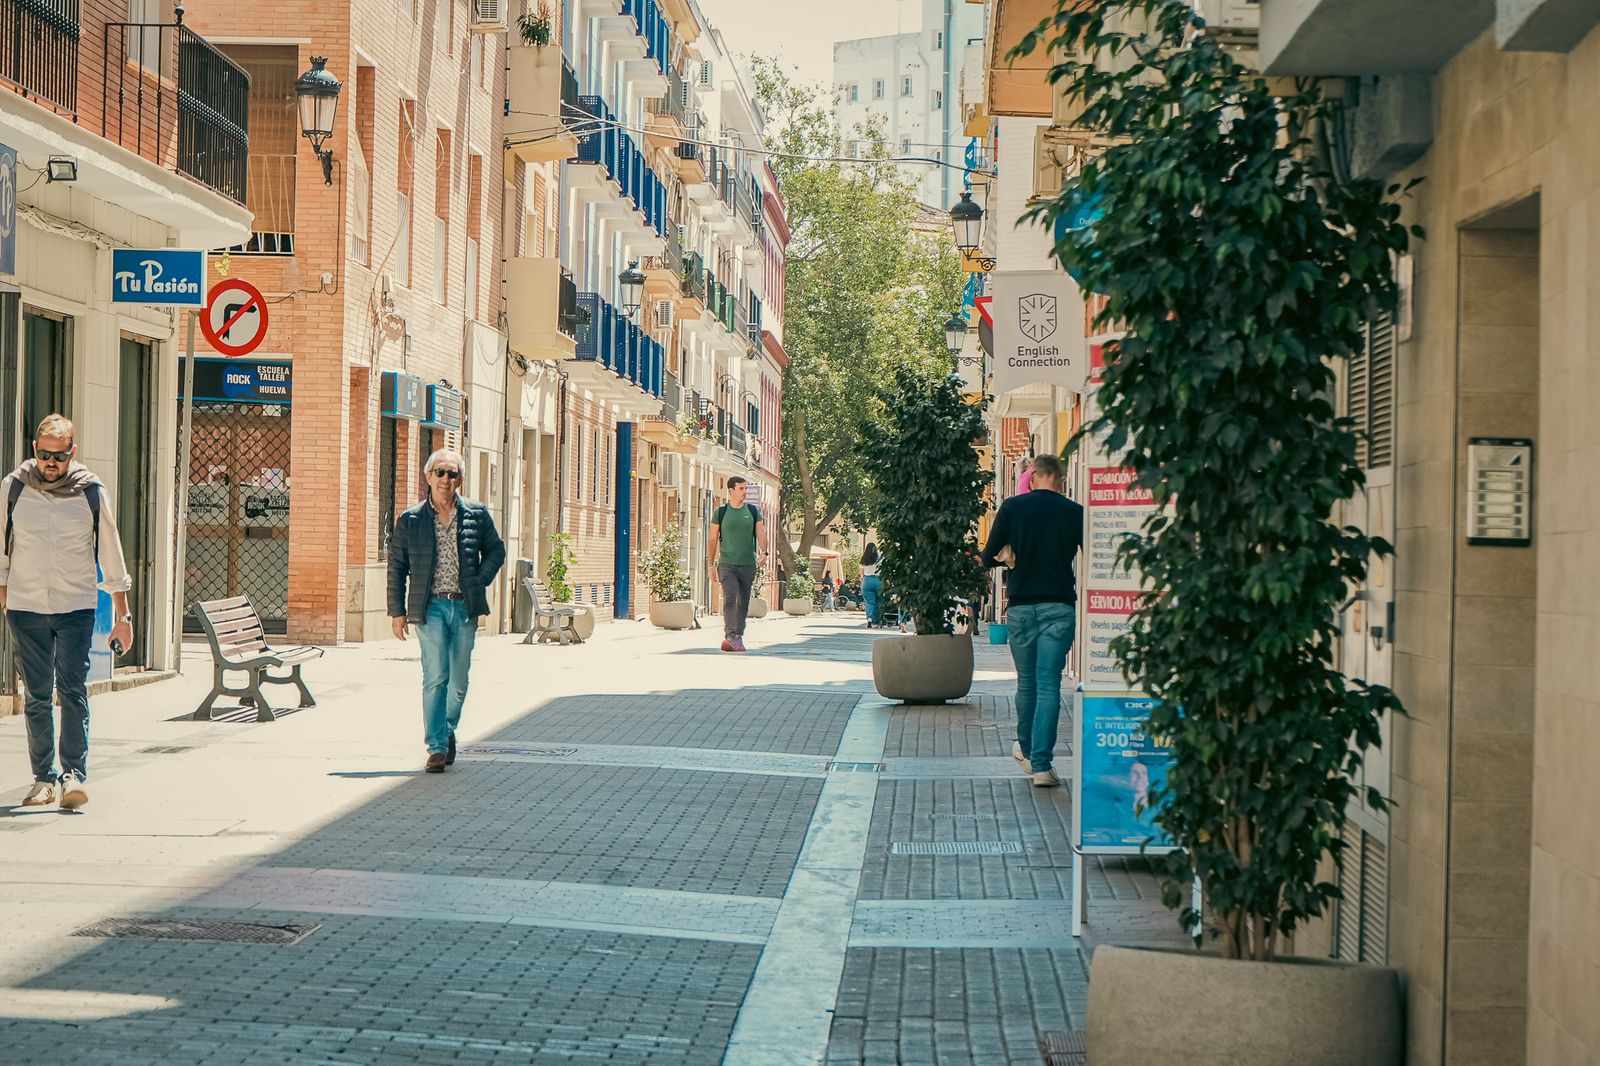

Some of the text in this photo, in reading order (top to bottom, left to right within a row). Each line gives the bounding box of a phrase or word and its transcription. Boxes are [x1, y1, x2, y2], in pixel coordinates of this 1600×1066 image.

[115, 260, 199, 294] Tu Pasión
[1017, 345, 1059, 358] English
[1008, 357, 1070, 368] Connection
[257, 365, 290, 376] ESCUELA
[226, 374, 251, 385] ROCK
[259, 373, 285, 382] TALLER
[259, 385, 286, 395] HUELVA
[1090, 489, 1115, 501] TABLETS
[1090, 595, 1124, 610] SERVICIO
[1125, 596, 1131, 610] A
[1095, 722, 1103, 730] EL
[1096, 732, 1129, 748] 300
